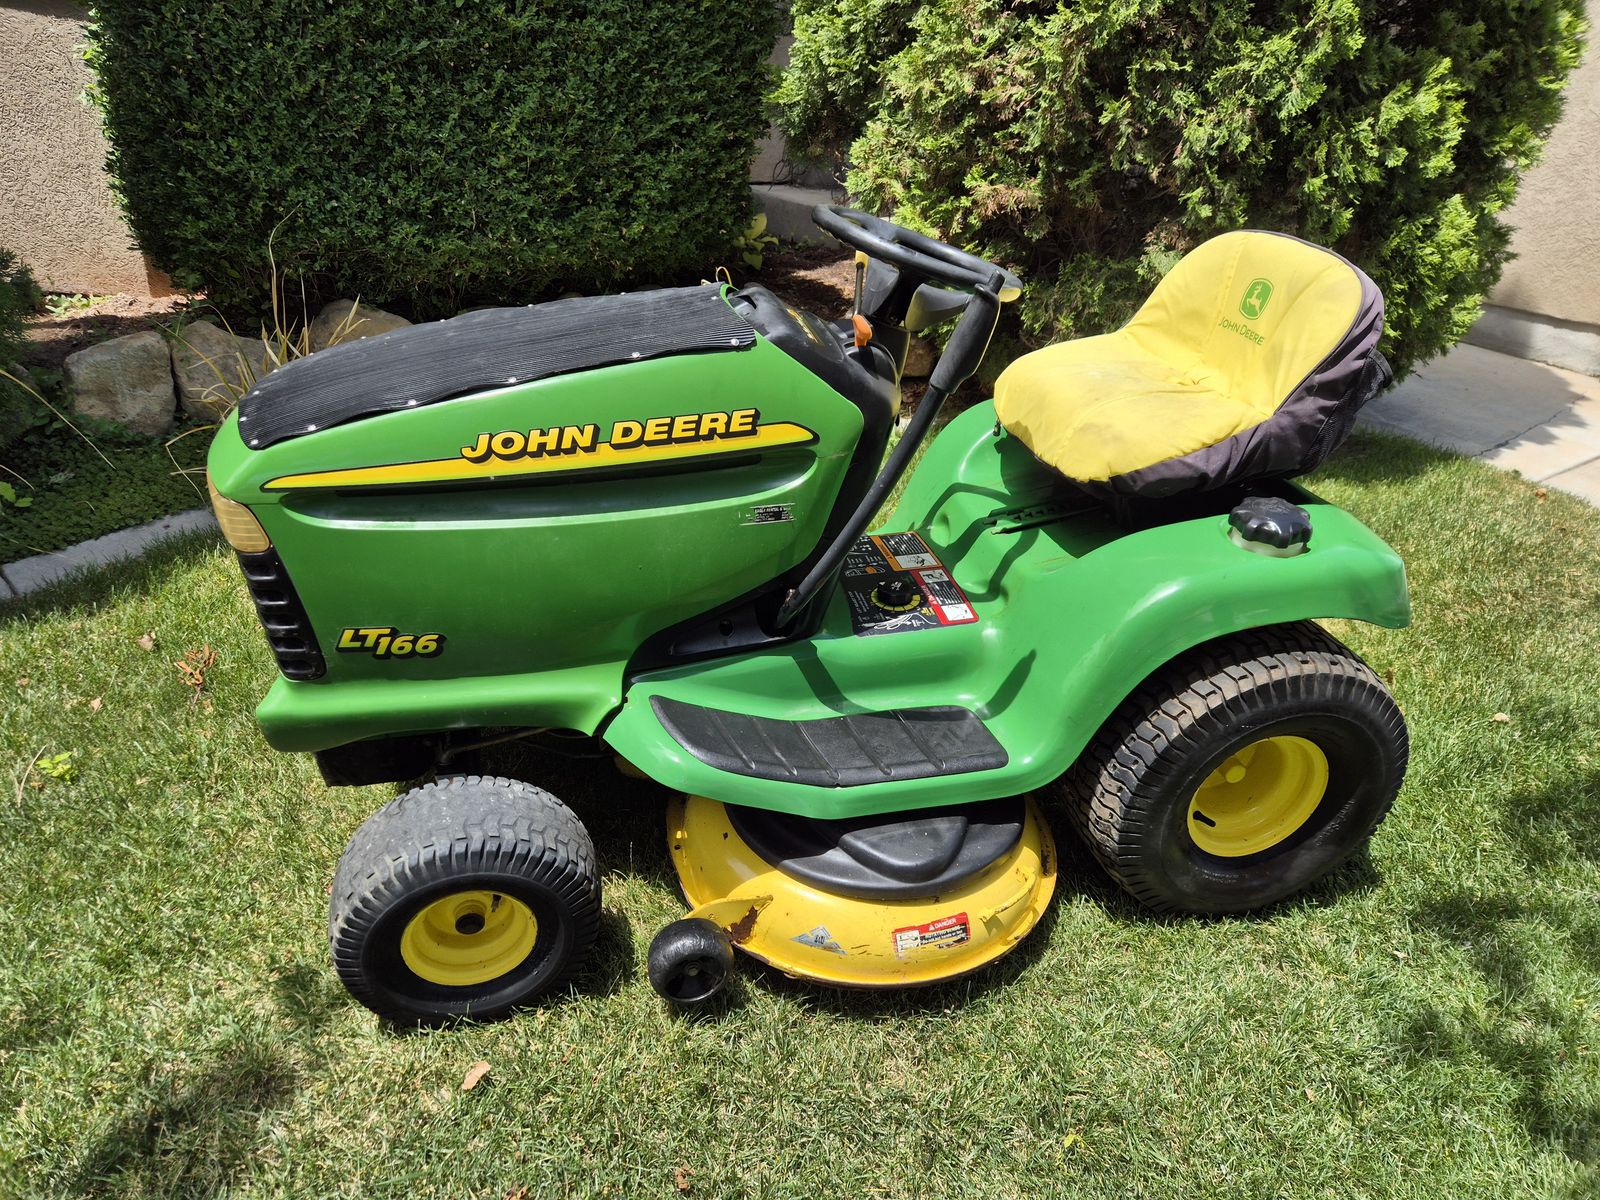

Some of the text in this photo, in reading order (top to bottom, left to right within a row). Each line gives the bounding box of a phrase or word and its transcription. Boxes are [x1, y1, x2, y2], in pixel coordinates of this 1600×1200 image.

[1218, 317, 1265, 346] JOHN DEERE
[460, 406, 759, 464] JOHN DEERE
[336, 626, 446, 658] LT166
[934, 918, 957, 929] DANGER
